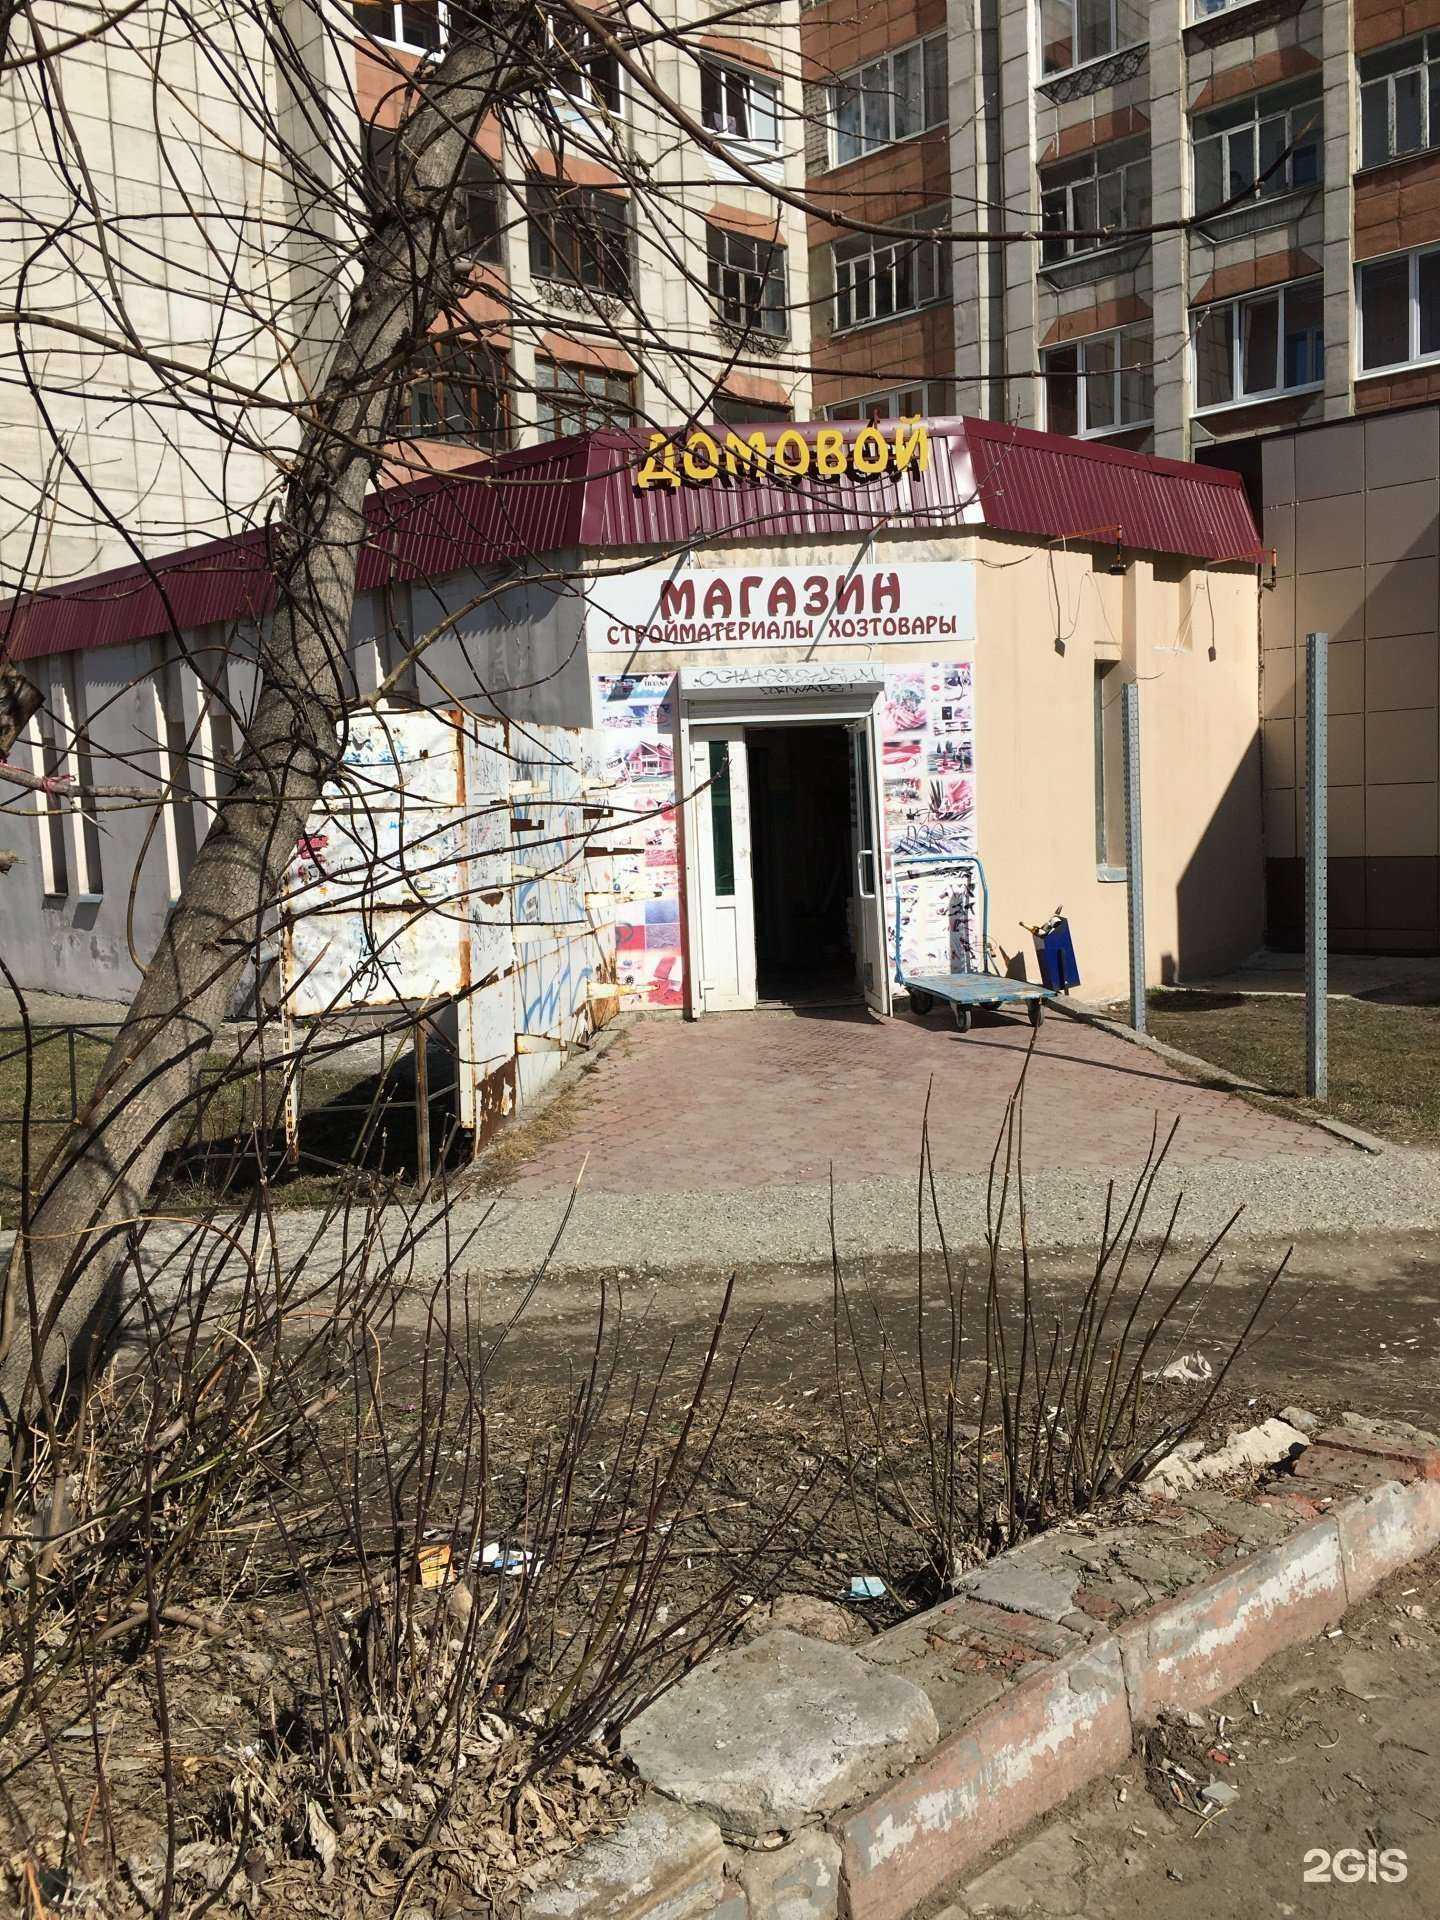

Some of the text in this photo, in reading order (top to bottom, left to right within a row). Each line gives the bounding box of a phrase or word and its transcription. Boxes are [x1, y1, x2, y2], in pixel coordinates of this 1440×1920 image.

[637, 414, 928, 488] ДОМОВОЙ
[660, 572, 901, 620] МАГАЗИН
[606, 615, 957, 645] СТРОЙМАТЕРИАЛЫ ХОЗТОВАРЫ
